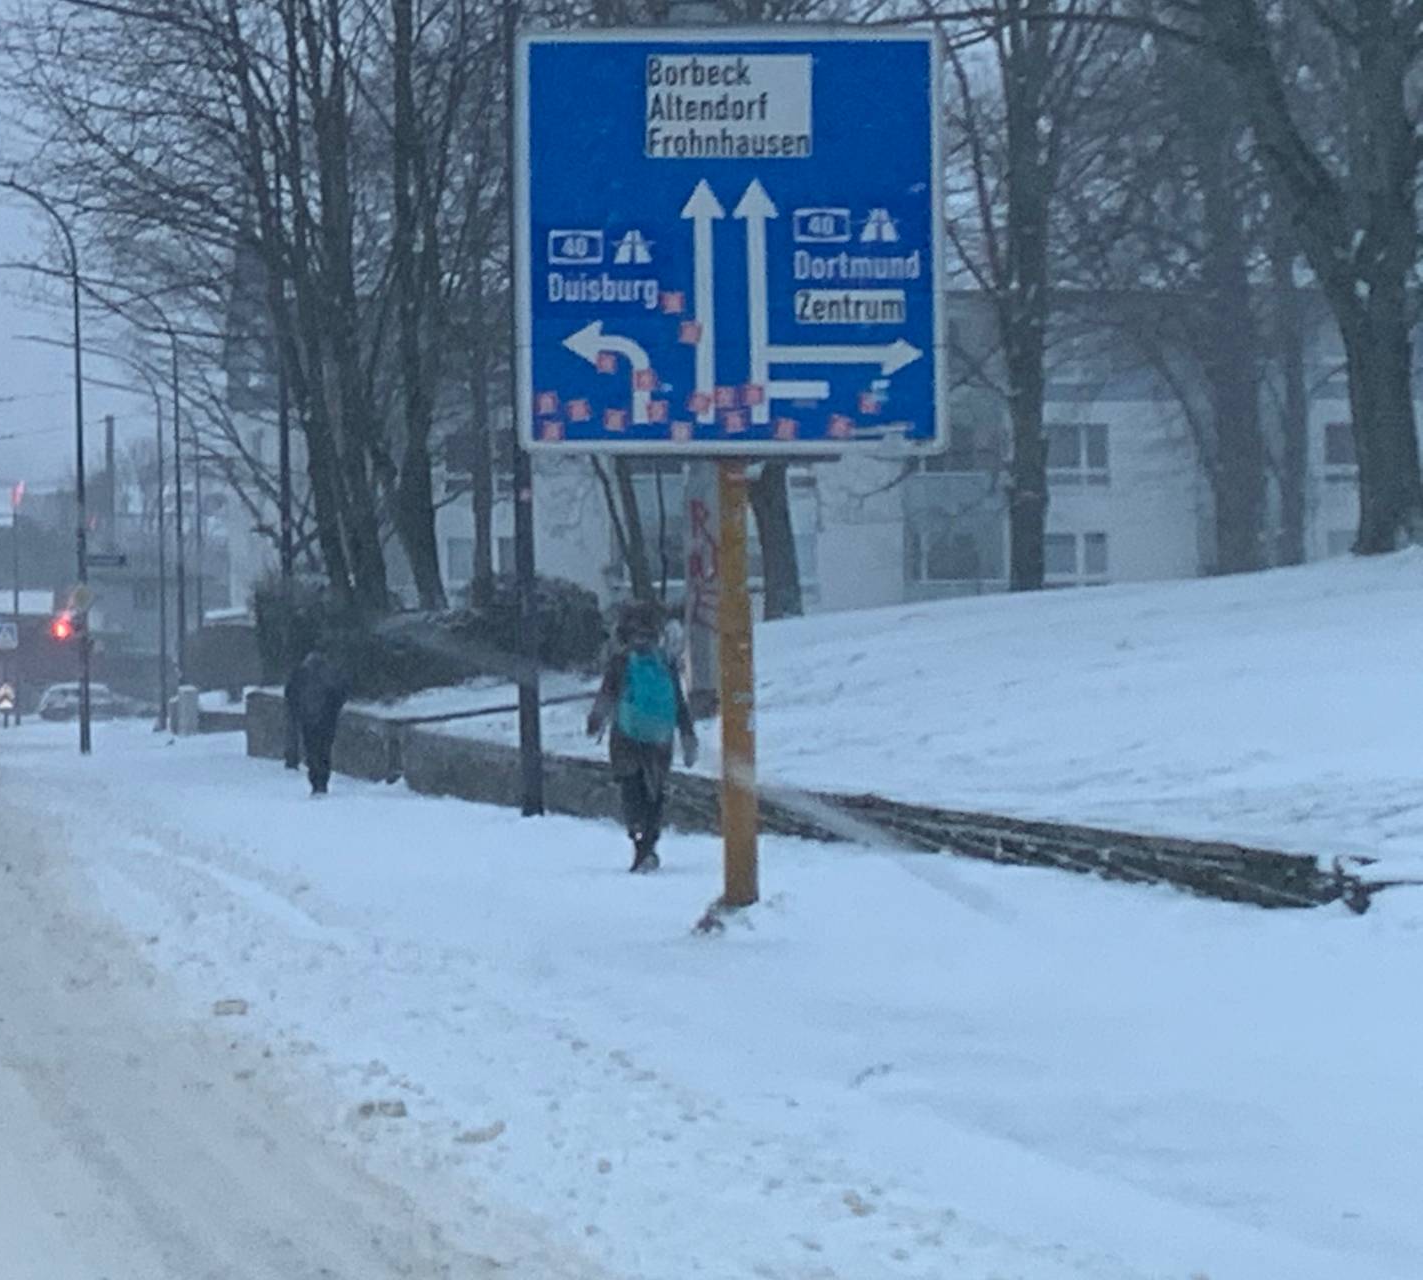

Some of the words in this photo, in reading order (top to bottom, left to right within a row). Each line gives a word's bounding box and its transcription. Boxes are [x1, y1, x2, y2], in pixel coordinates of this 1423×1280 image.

[648, 57, 752, 86] Borbeck
[649, 92, 768, 121] Altendorf
[648, 127, 810, 156] Frohnhausen
[808, 215, 834, 236] 40
[561, 237, 588, 257] 40
[794, 249, 920, 279] Dortmund
[548, 272, 659, 310] Duisburg
[797, 292, 904, 321] Zentrum
